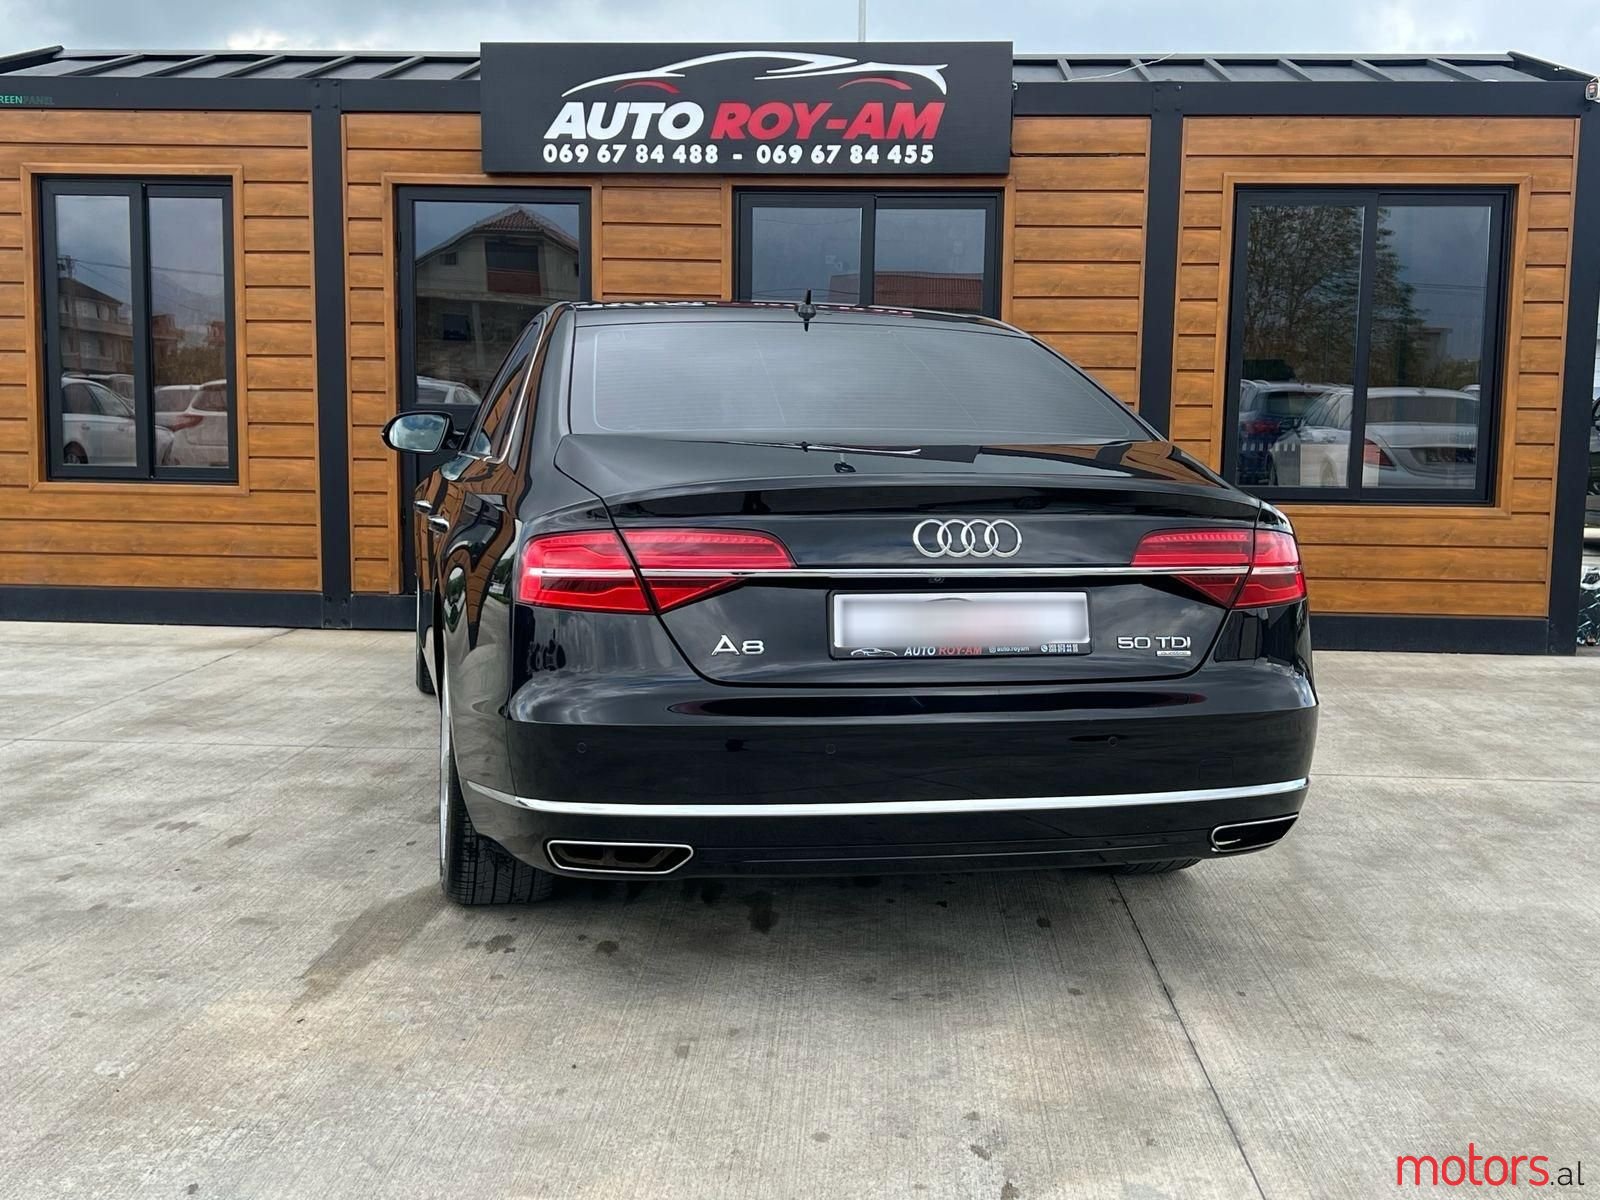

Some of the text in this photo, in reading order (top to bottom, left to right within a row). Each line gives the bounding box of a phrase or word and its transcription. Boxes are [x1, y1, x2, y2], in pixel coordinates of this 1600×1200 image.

[543, 101, 945, 140] AUTO ROY-AM
[543, 144, 589, 163] 069
[597, 144, 627, 163] 67
[635, 144, 664, 164] 84
[672, 144, 718, 164] 488
[756, 144, 803, 165] 069
[811, 144, 841, 164] 67
[850, 144, 879, 165] 84
[887, 144, 934, 165] 455
[711, 634, 765, 656] A8
[904, 646, 936, 656] AUTO
[938, 646, 982, 656] ROY-AM
[1117, 636, 1191, 649] 50 TDI
